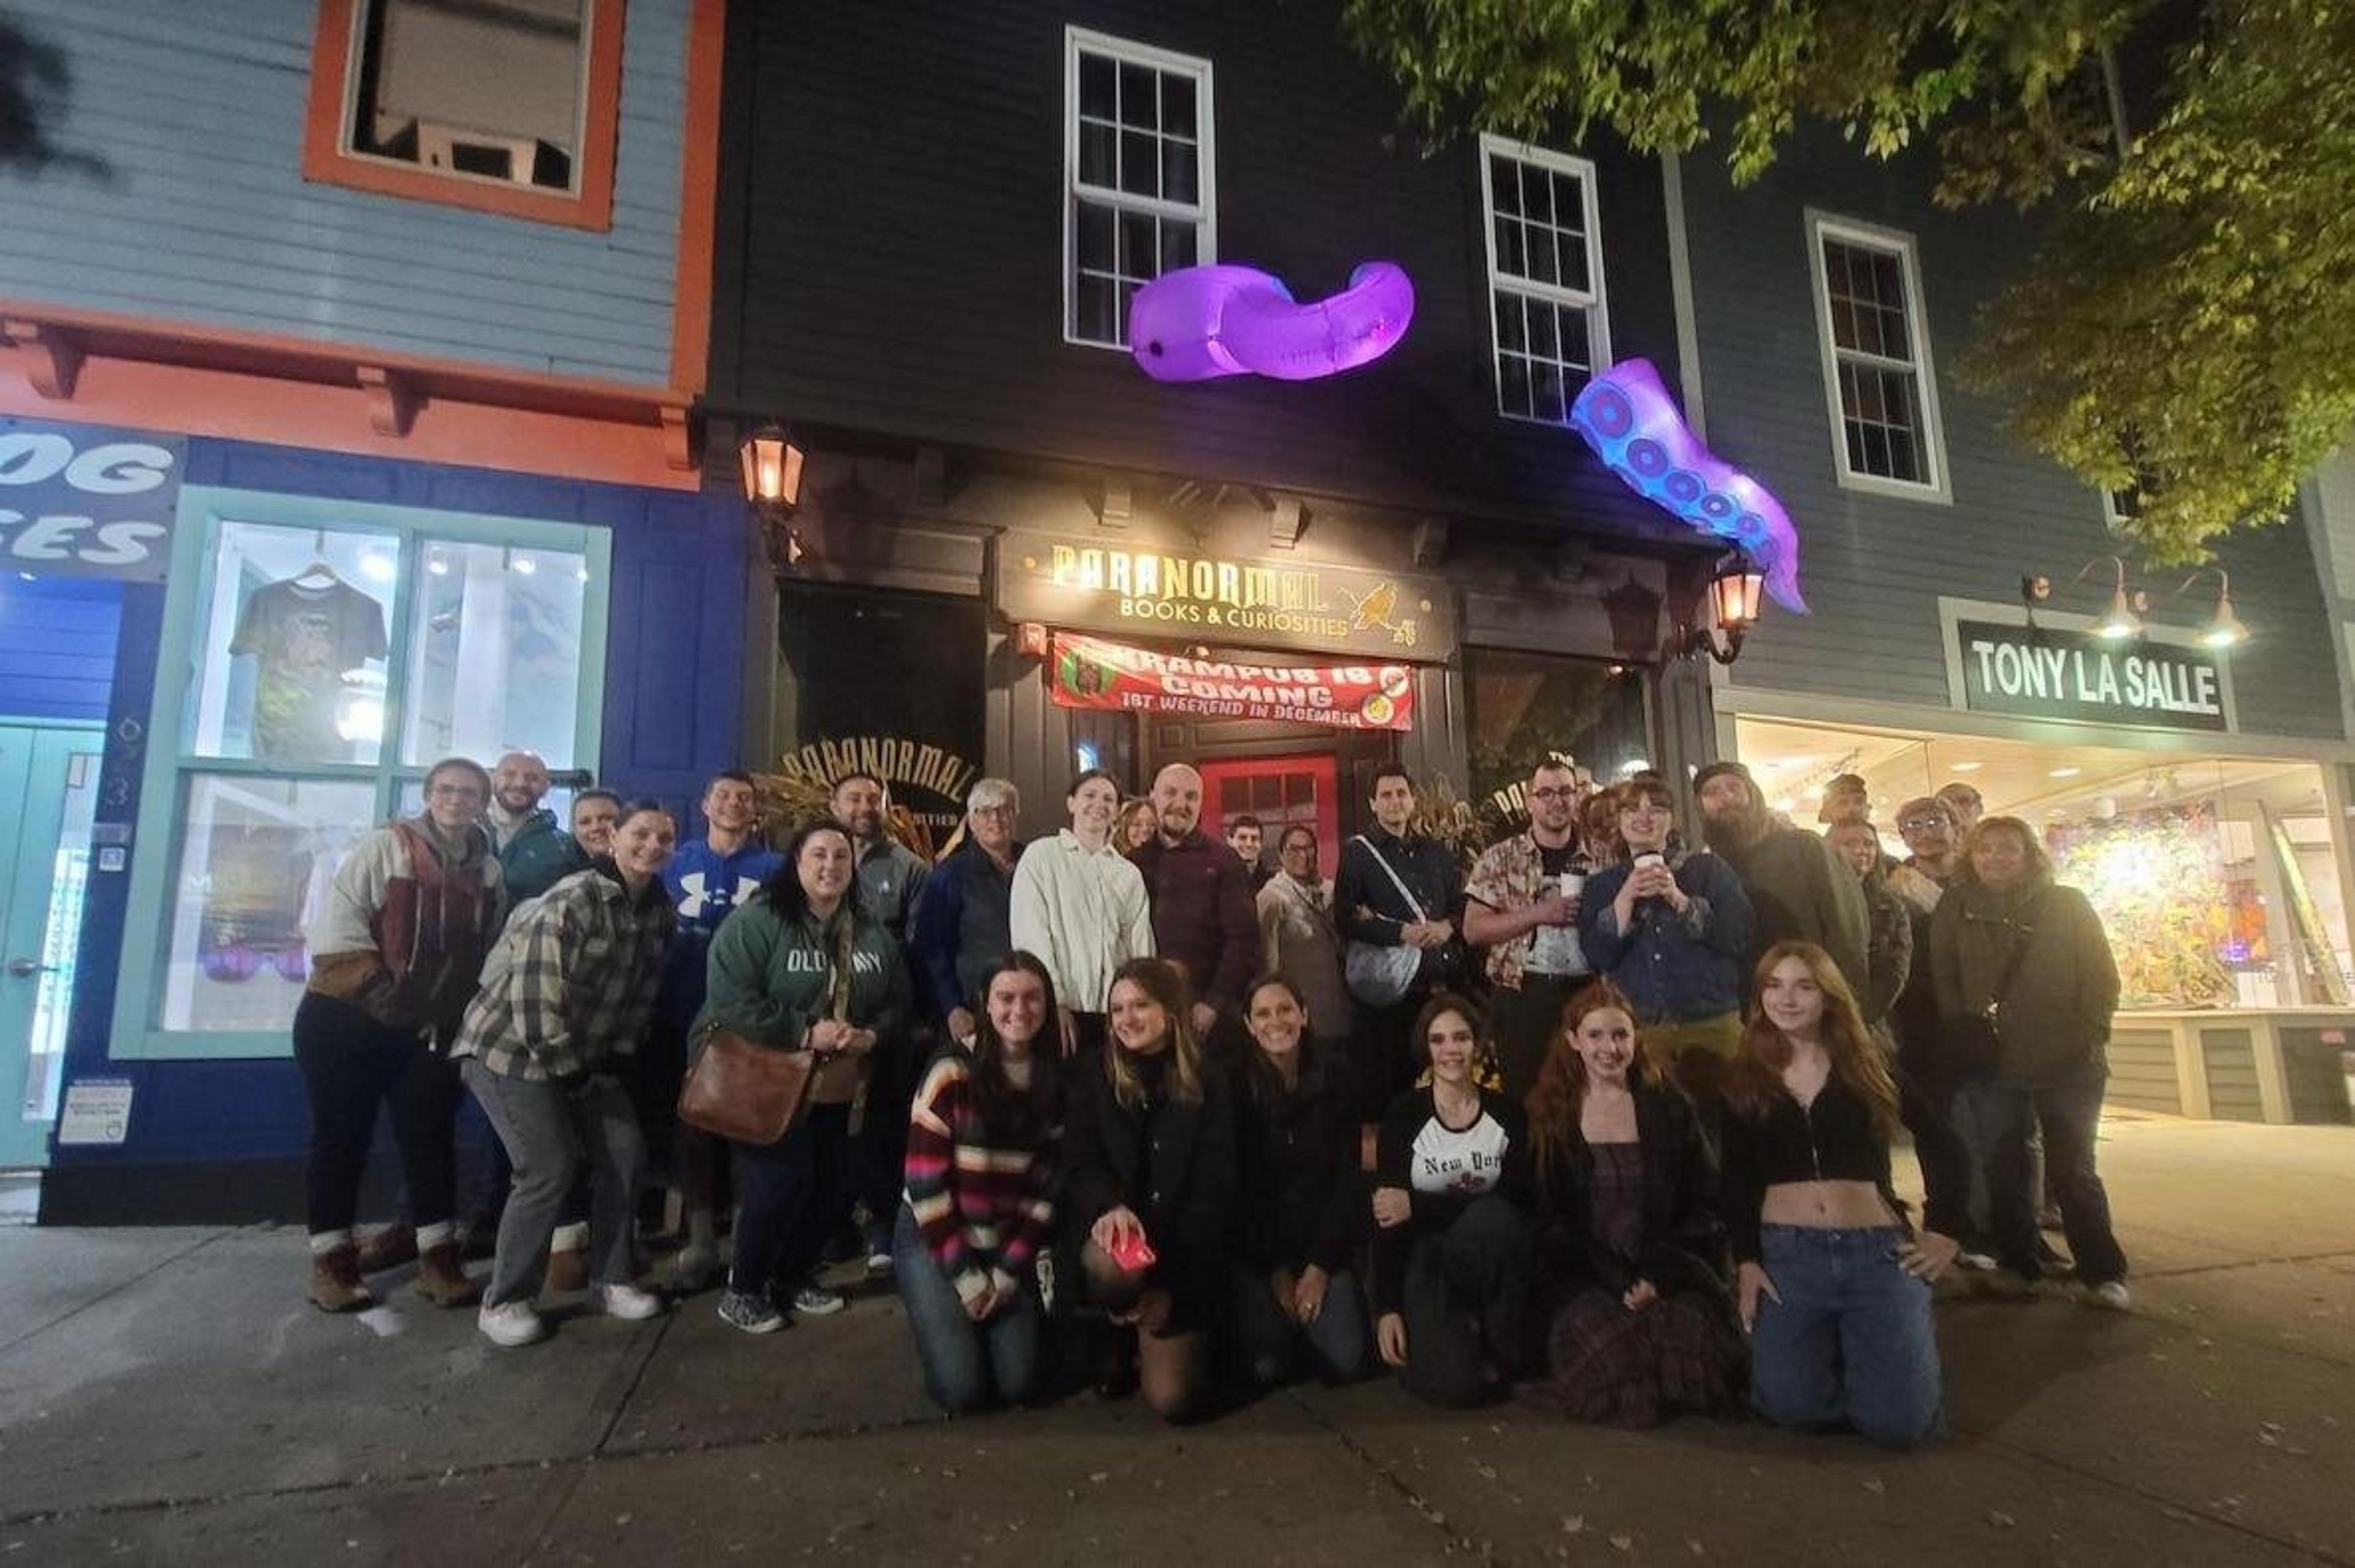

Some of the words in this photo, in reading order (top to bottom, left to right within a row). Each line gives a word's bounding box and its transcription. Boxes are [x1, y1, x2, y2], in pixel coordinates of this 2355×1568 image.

[1052, 545, 1329, 612] PARANORMAL
[1120, 598, 1200, 622] BOOKS
[1207, 606, 1222, 624] &
[1227, 609, 1348, 637] CURIOSITIES
[1161, 674, 1333, 708] COMING
[1972, 640, 2066, 699] TONY
[2075, 651, 2121, 705] LA
[2126, 656, 2219, 715] SALLE
[1160, 695, 1244, 715] WEEKEND
[1249, 703, 1269, 717] IN
[1274, 705, 1363, 728] DECEMBER
[787, 949, 827, 971] OLD
[1425, 1157, 1463, 1175] New
[1472, 1151, 1502, 1170] Yor
